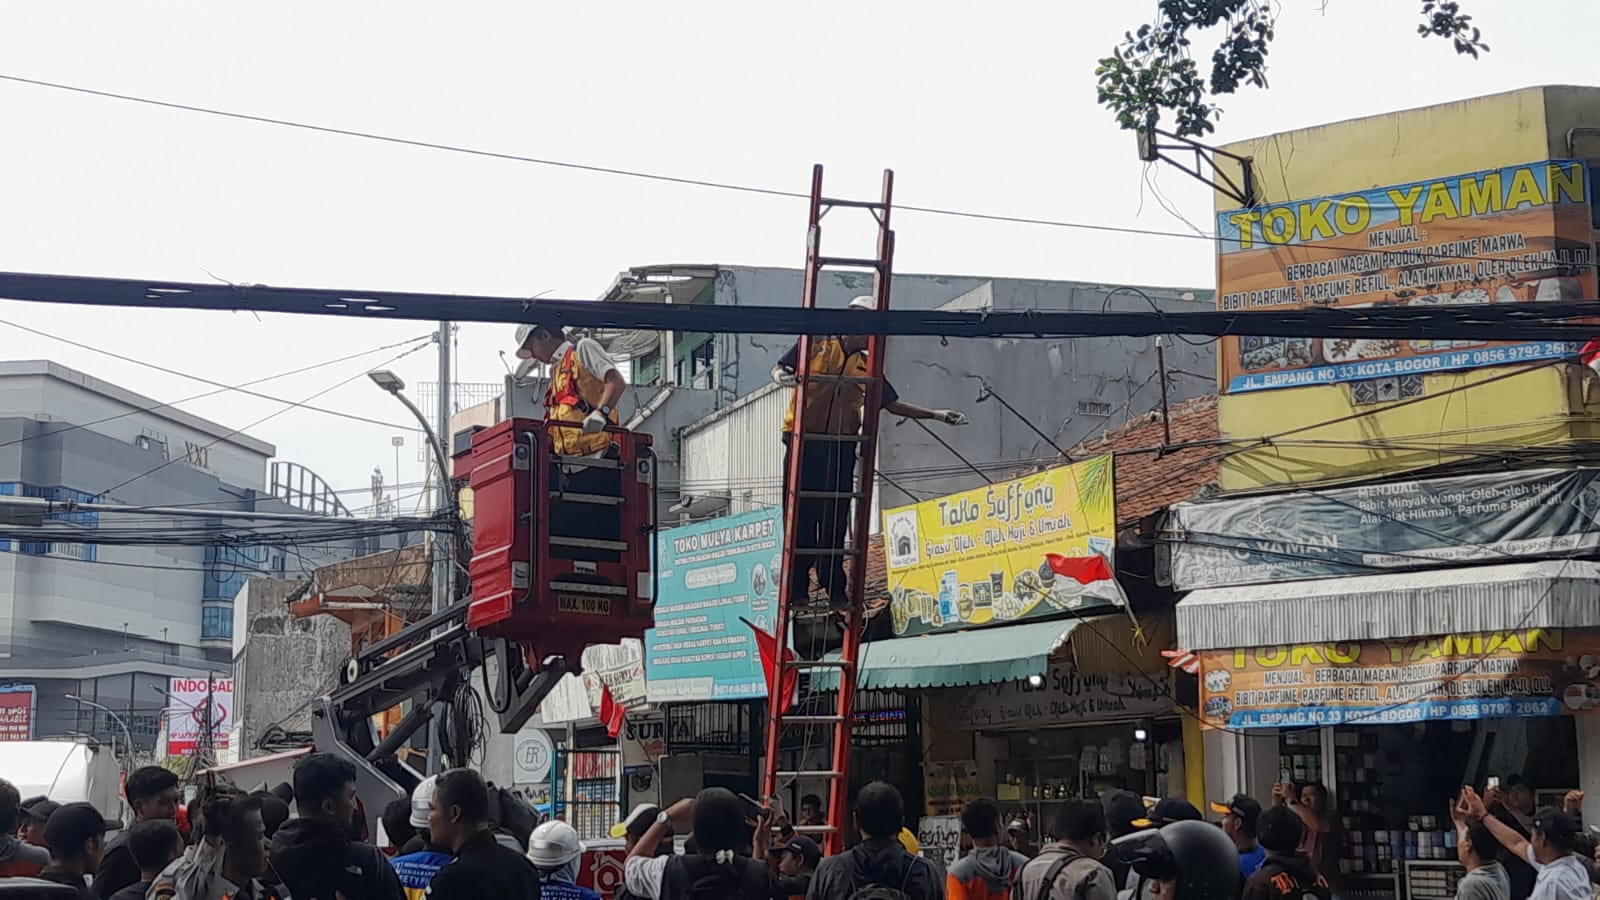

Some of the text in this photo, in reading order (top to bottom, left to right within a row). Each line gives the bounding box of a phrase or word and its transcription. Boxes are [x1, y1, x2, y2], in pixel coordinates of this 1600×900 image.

[1230, 163, 1585, 249] TOKO YAMAN
[1286, 233, 1526, 281] BERBAGAI MACAM PRODUK PARFUME MARWA
[1223, 293, 1248, 311] BIBIT
[1303, 280, 1351, 299] PARFUME
[1398, 268, 1428, 288] ALAT
[1243, 377, 1261, 389] JL.
[1264, 370, 1315, 386] EMPANG
[1317, 369, 1337, 380] NO
[1339, 366, 1354, 379] 33
[1357, 361, 1391, 376] KOTA
[1395, 355, 1441, 371] BOGOR
[1451, 353, 1470, 366] HP
[1473, 350, 1506, 364] 0856
[1508, 345, 1541, 360] 9792
[1545, 341, 1578, 356] 2662
[1387, 494, 1428, 510] Minyak
[1458, 501, 1507, 516] Parfume
[674, 519, 775, 553] TOKO MULYA KARPET
[581, 598, 595, 612] 100
[597, 600, 609, 613] KG
[1314, 668, 1361, 683] BERBAGAI
[1363, 667, 1400, 683] MACAM
[1401, 664, 1434, 682] PRODUK
[1435, 660, 1479, 677] PARFUME
[1480, 658, 1519, 674] MARWA
[1235, 690, 1256, 706] BIBIT
[1302, 687, 1345, 703] PARFUME
[1386, 684, 1411, 701] ALAT
[1260, 712, 1306, 724] EMPANG
[1308, 711, 1325, 722] NO
[1328, 711, 1341, 721] 33
[1344, 710, 1378, 723] KOTA
[1381, 708, 1422, 722] BOGOR
[1430, 705, 1447, 717] HP
[1481, 702, 1513, 715] 9792
[1516, 701, 1549, 714] 2662
